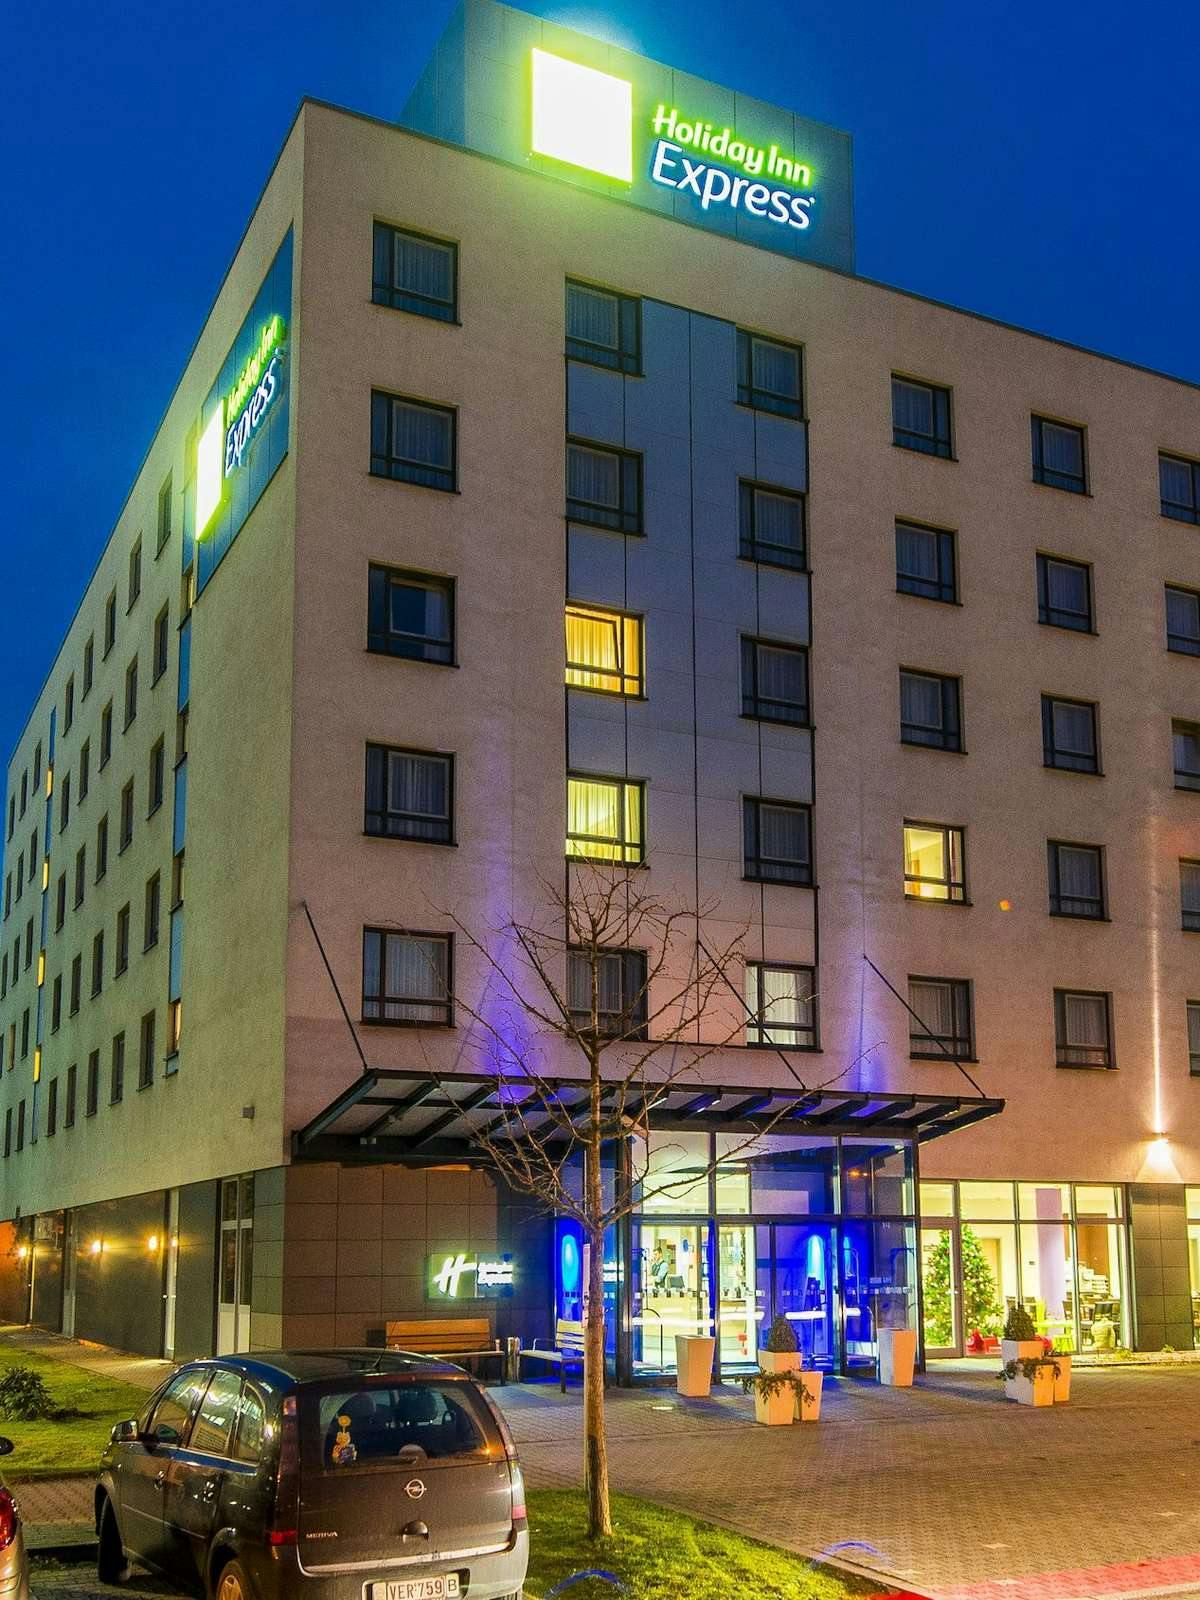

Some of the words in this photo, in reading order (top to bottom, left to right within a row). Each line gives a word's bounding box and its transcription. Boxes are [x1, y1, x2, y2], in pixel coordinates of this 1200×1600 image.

[652, 104, 763, 175] Holiday
[768, 145, 810, 186] Inn
[652, 141, 813, 229] Express
[225, 358, 277, 477] Express
[447, 1579, 457, 1591] B
